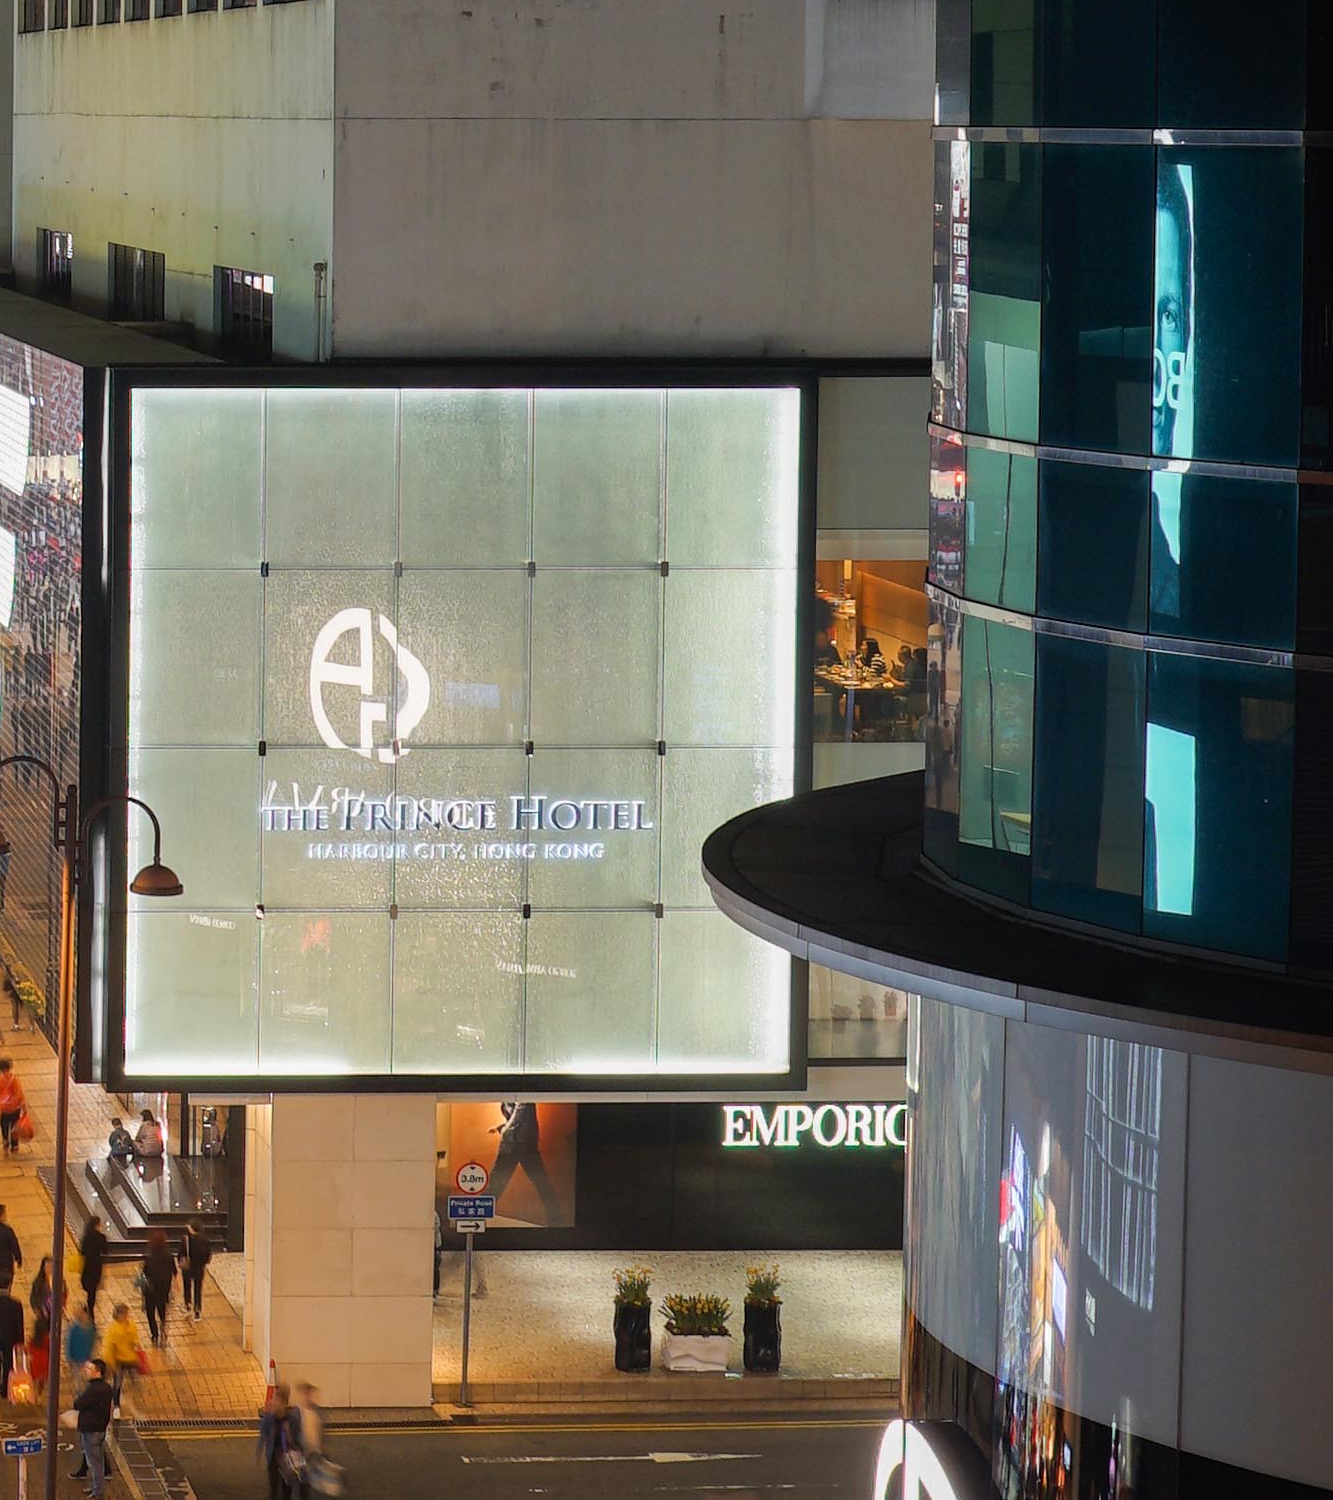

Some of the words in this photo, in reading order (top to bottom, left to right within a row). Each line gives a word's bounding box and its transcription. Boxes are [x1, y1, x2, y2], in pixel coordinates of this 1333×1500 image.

[263, 805, 329, 832] THE
[343, 797, 497, 832] PRINCE
[510, 795, 654, 832] HOTEL
[308, 842, 408, 860] HARBOUR
[474, 842, 536, 860] HONG
[544, 842, 605, 860] KONG
